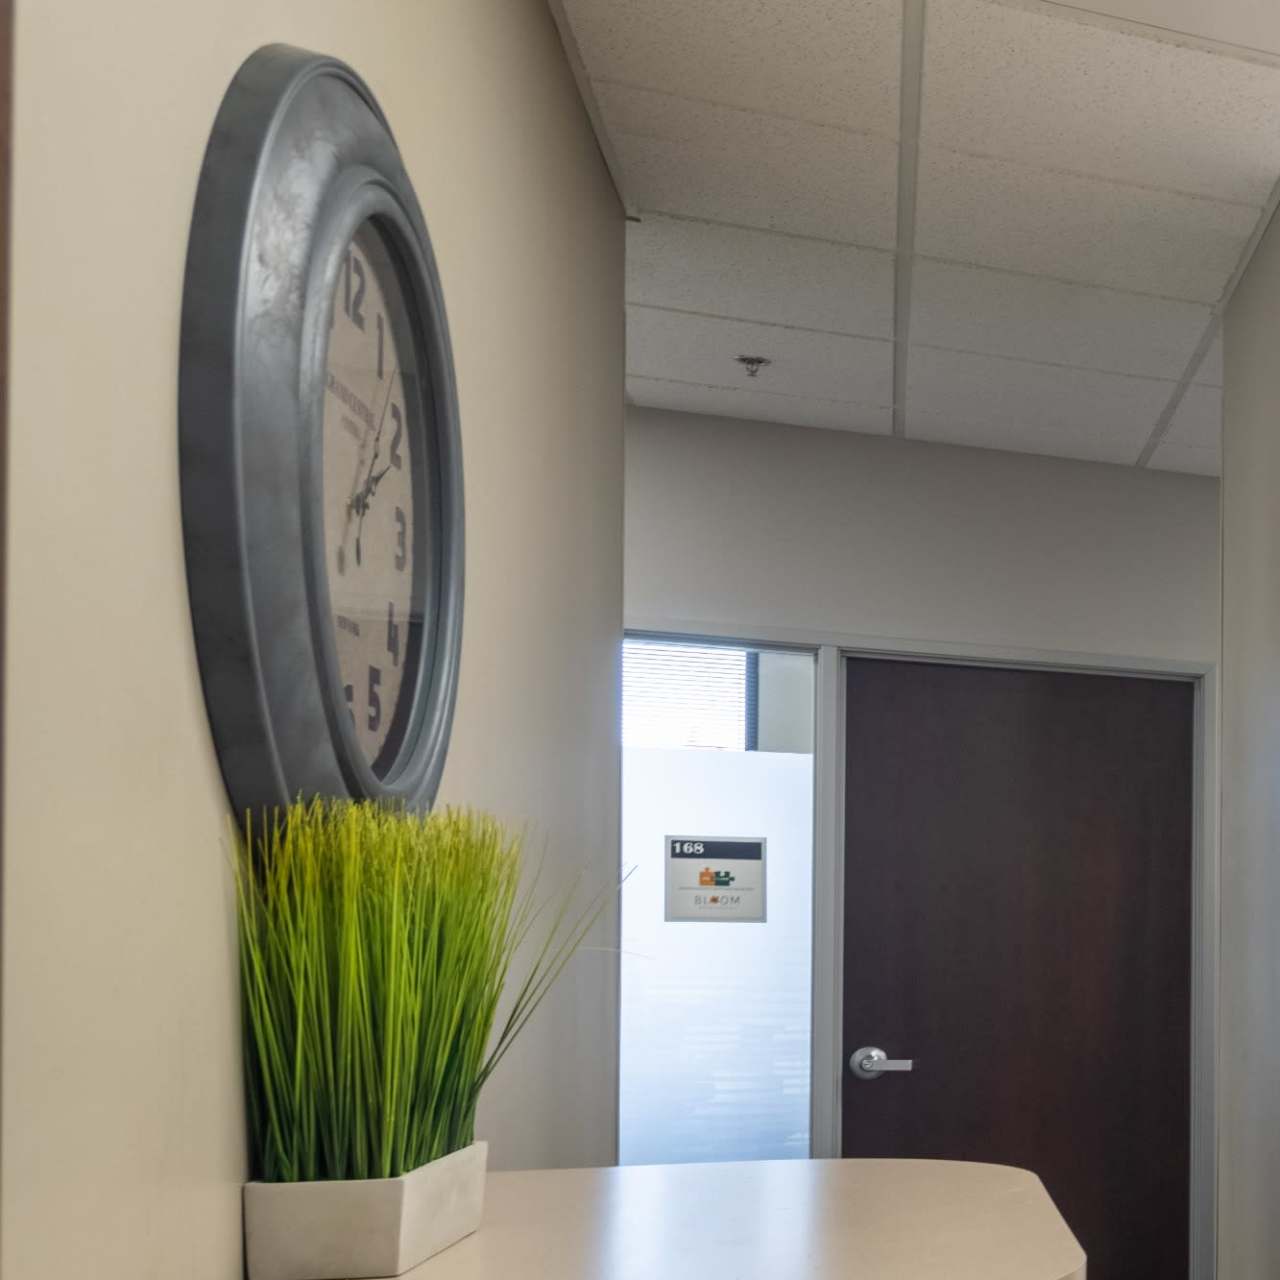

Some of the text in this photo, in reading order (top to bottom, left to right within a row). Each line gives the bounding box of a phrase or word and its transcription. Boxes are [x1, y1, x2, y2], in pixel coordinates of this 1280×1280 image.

[344, 252, 366, 333] 12
[377, 313, 384, 380] 1
[390, 401, 403, 470] 2
[395, 505, 407, 573] 3
[387, 600, 399, 667] 4
[367, 663, 382, 733] 5
[673, 842, 704, 854] 168
